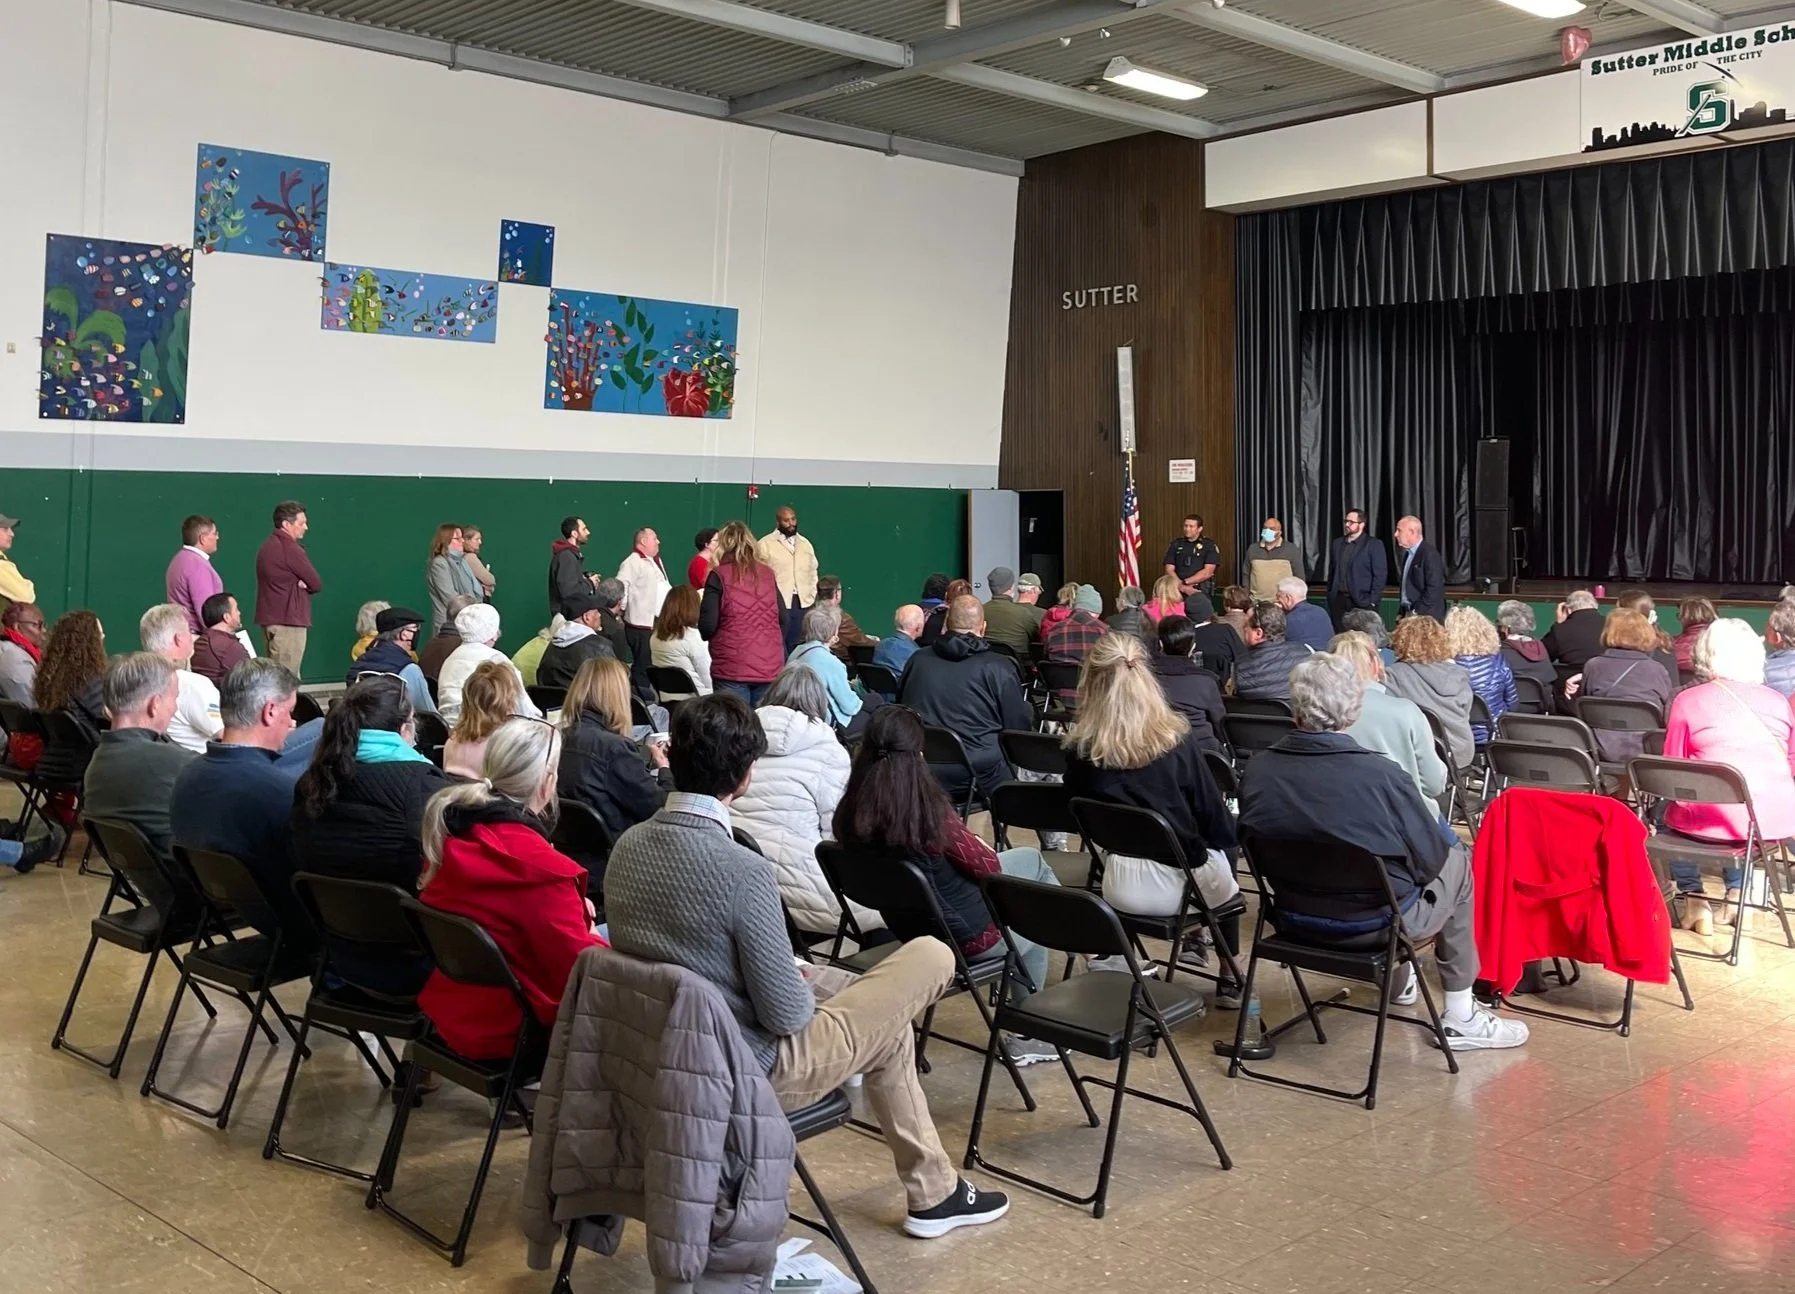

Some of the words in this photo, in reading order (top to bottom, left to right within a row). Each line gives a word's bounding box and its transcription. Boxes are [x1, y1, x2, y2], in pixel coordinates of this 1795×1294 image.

[1591, 53, 1659, 75] Sutter
[1664, 36, 1747, 62] Middle
[1653, 64, 1683, 76] PRIDE
[1685, 61, 1699, 70] OF
[1716, 54, 1737, 65] THE
[1739, 50, 1763, 61] CITY
[1062, 284, 1138, 309] SUTTER
